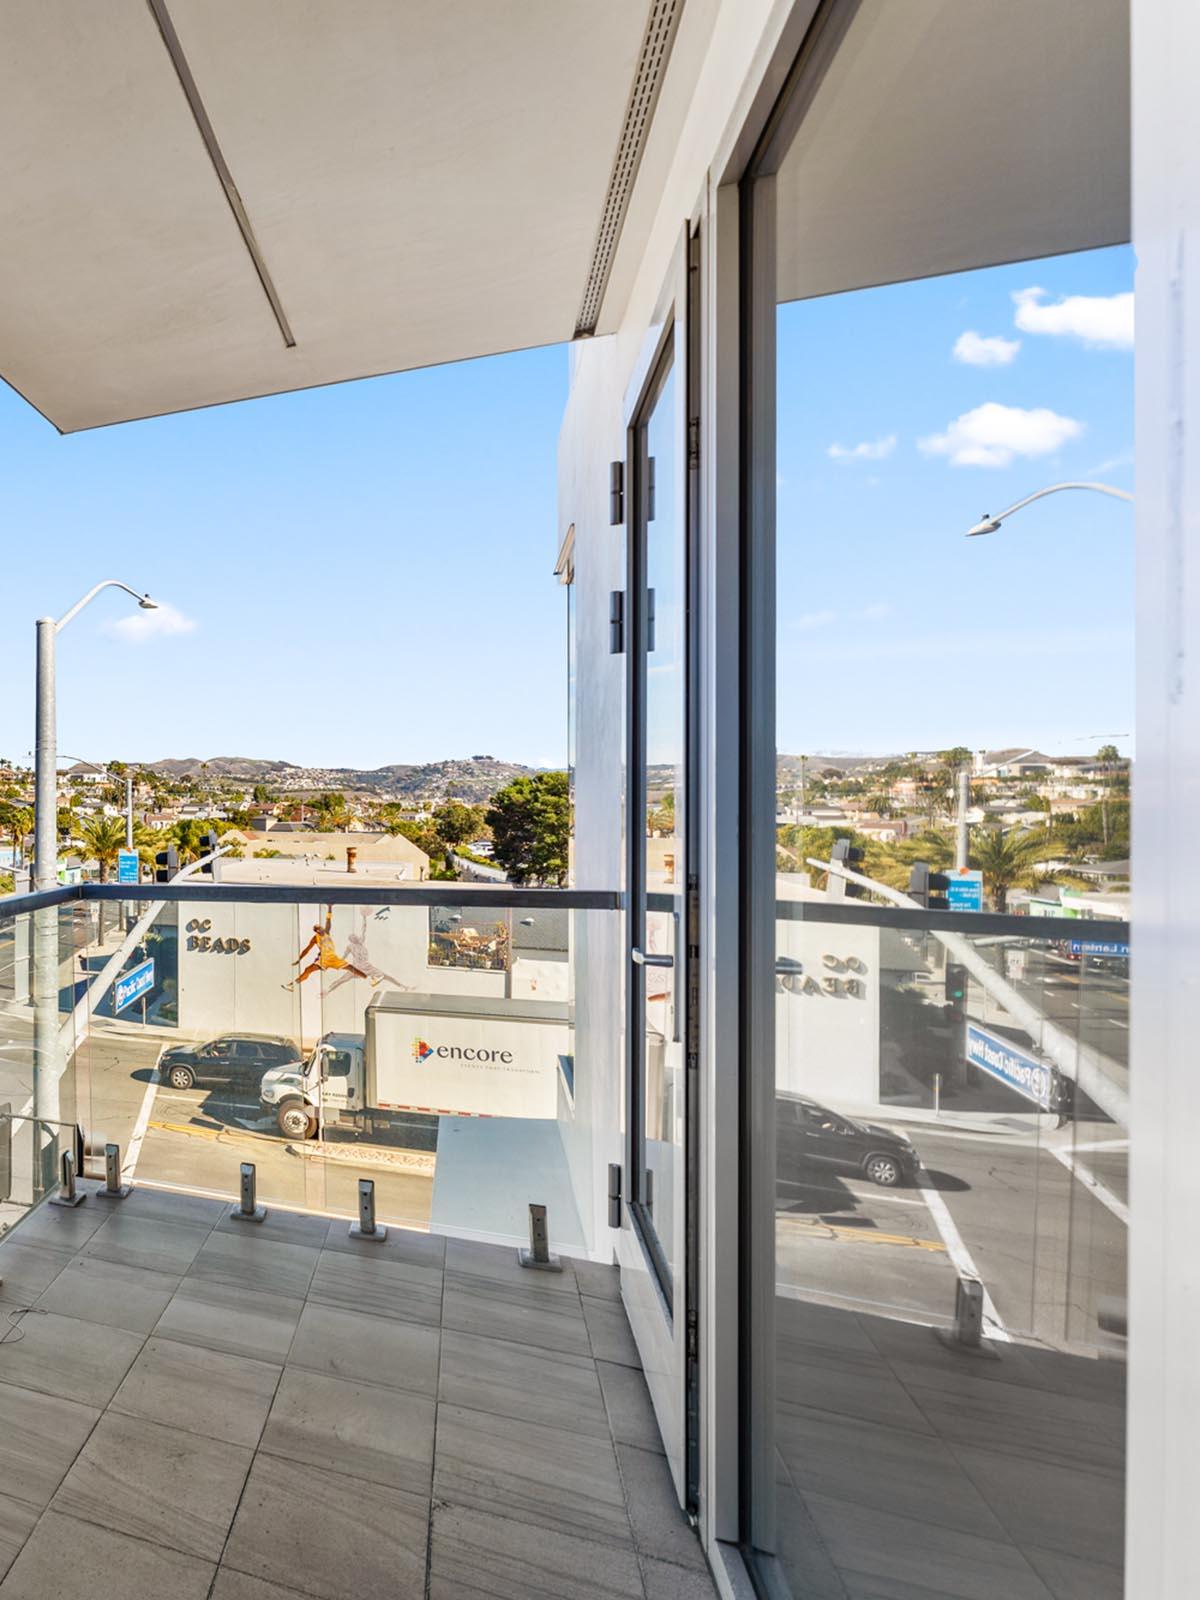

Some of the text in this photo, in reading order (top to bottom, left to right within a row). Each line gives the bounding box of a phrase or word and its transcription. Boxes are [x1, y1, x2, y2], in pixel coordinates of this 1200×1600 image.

[185, 918, 212, 934] OC
[186, 935, 251, 956] BEADS
[437, 1045, 513, 1064] encore
